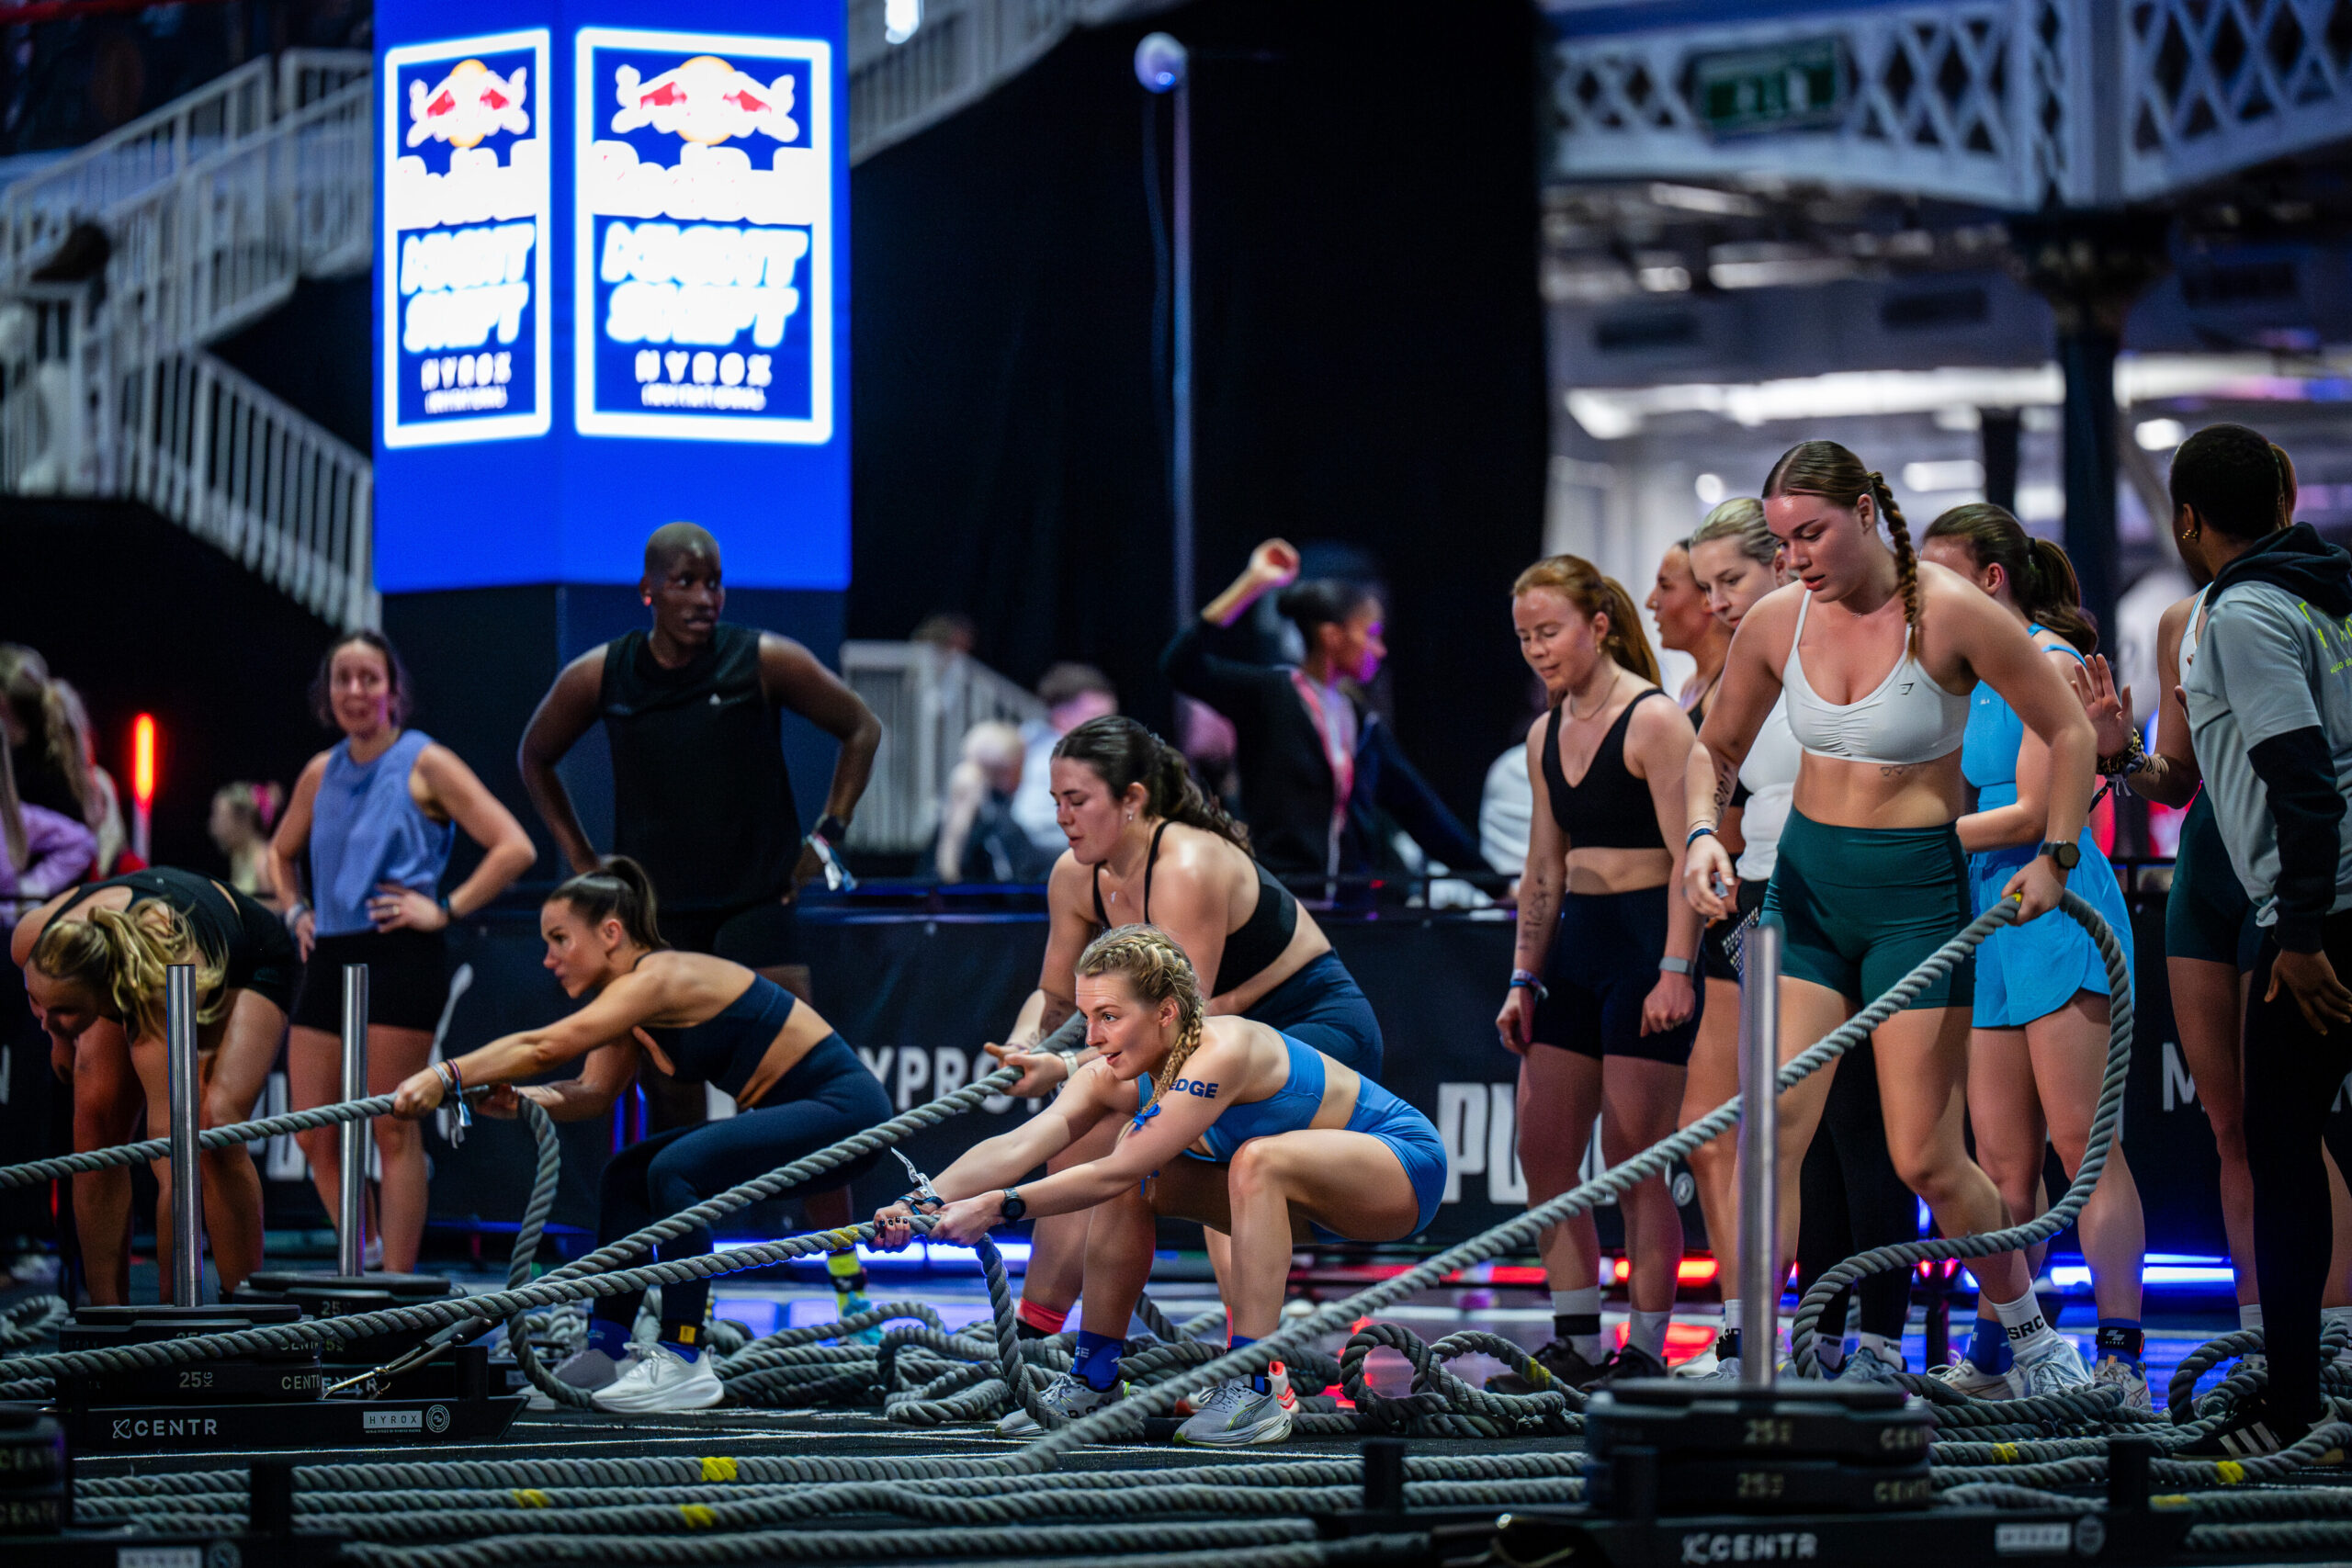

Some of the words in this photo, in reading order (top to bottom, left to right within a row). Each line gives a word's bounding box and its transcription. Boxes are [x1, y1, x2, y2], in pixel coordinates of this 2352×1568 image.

[2007, 1314, 2045, 1340] SRC
[178, 1371, 202, 1388] 25
[134, 1418, 218, 1437] CENTR
[369, 1415, 418, 1425] HYROX
